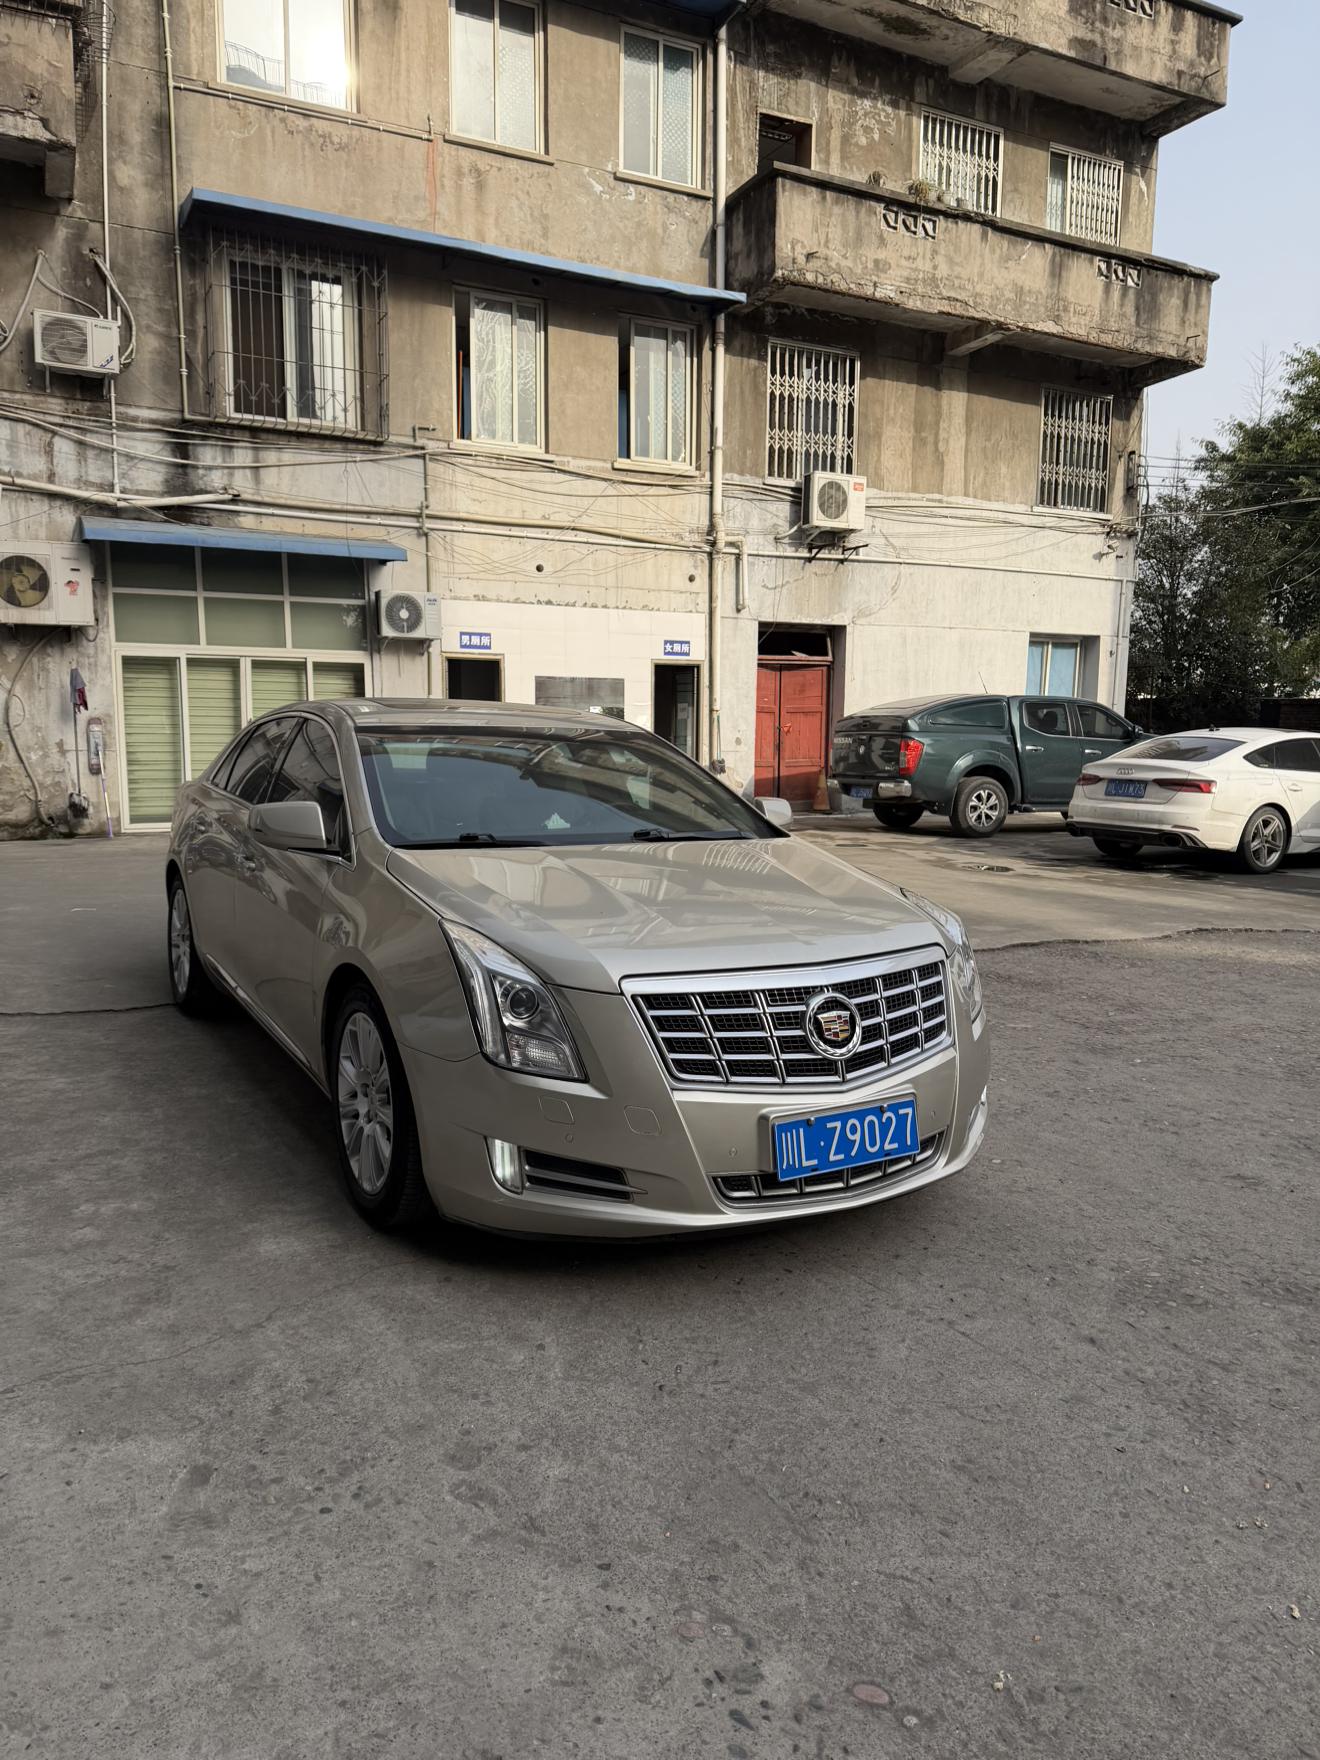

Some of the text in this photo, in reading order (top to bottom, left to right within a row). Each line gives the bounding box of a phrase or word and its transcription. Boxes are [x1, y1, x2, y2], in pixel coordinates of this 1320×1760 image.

[461, 635, 491, 646] 男厕所
[664, 643, 690, 653] 女厕所
